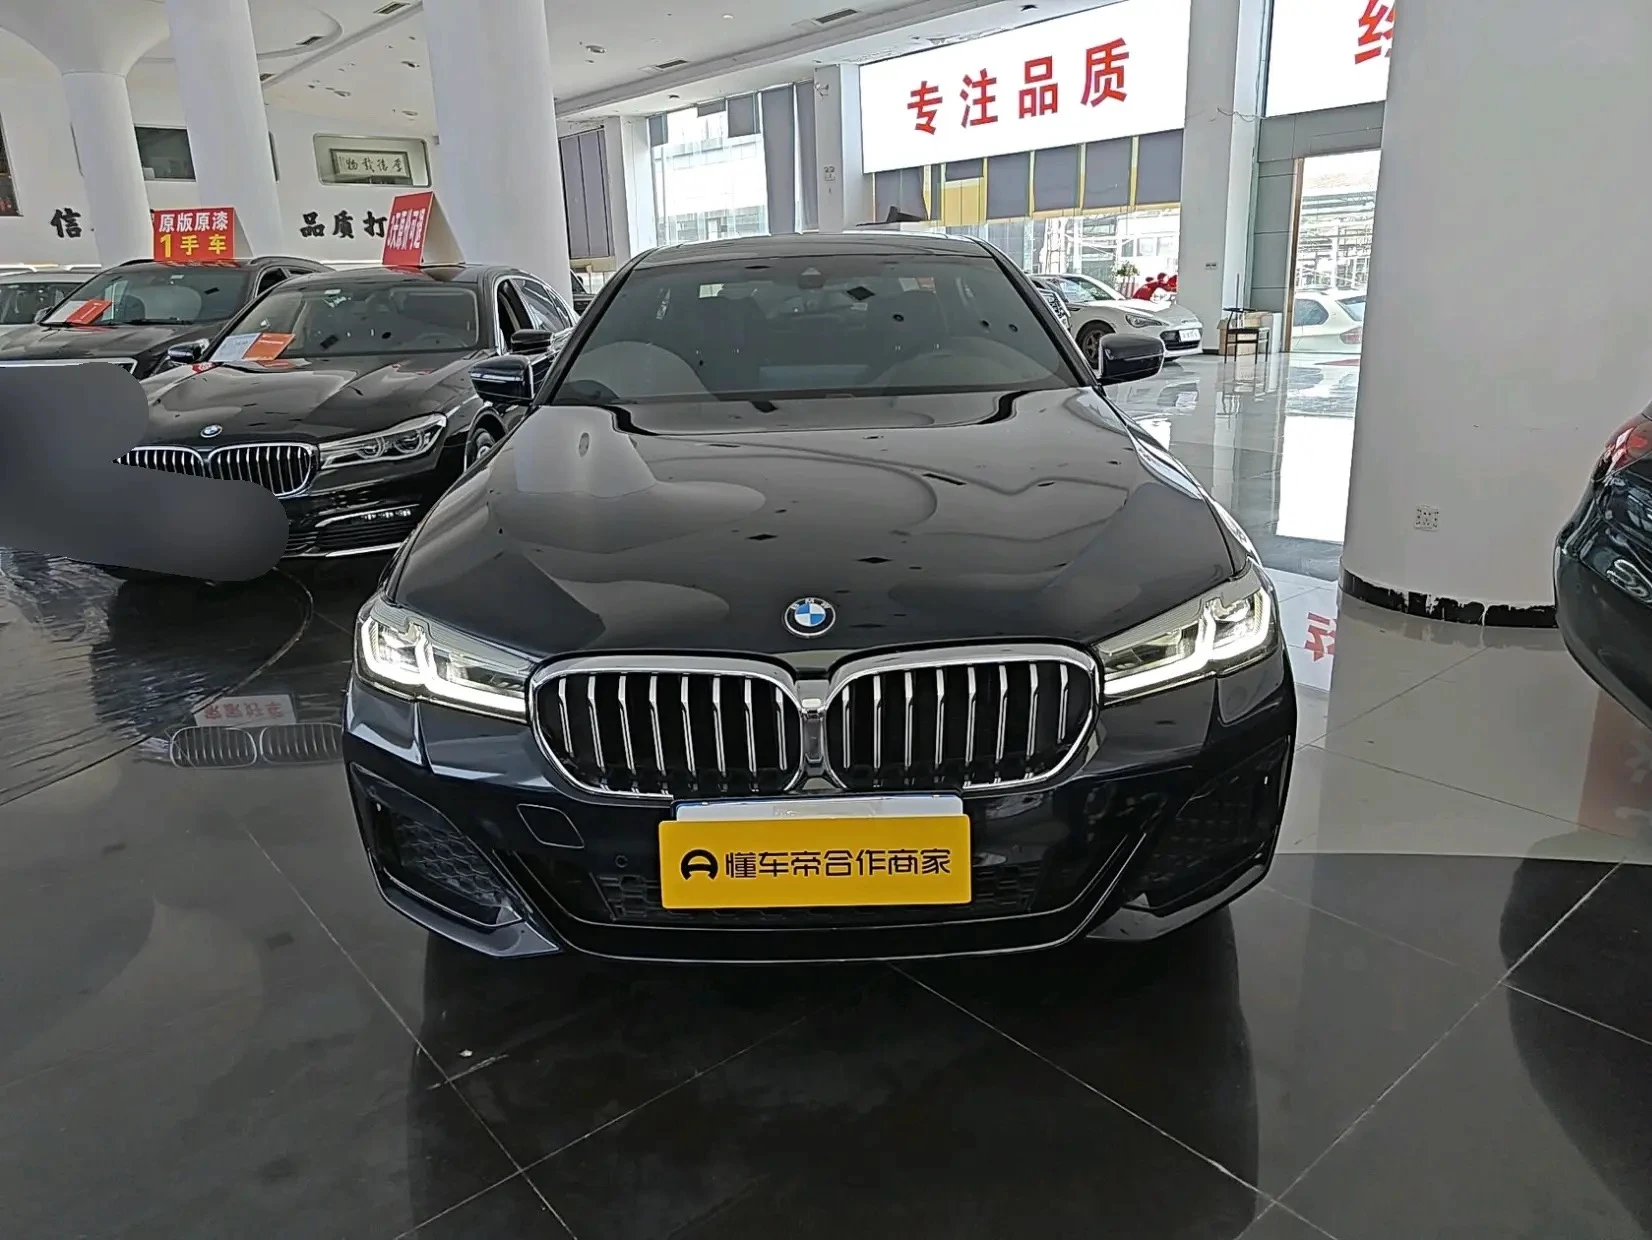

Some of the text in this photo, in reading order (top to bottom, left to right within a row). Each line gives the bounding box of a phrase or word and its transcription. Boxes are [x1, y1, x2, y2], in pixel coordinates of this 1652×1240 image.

[907, 37, 1129, 135] 专注品质
[50, 207, 83, 238] 信
[159, 211, 229, 232] 原版原漆
